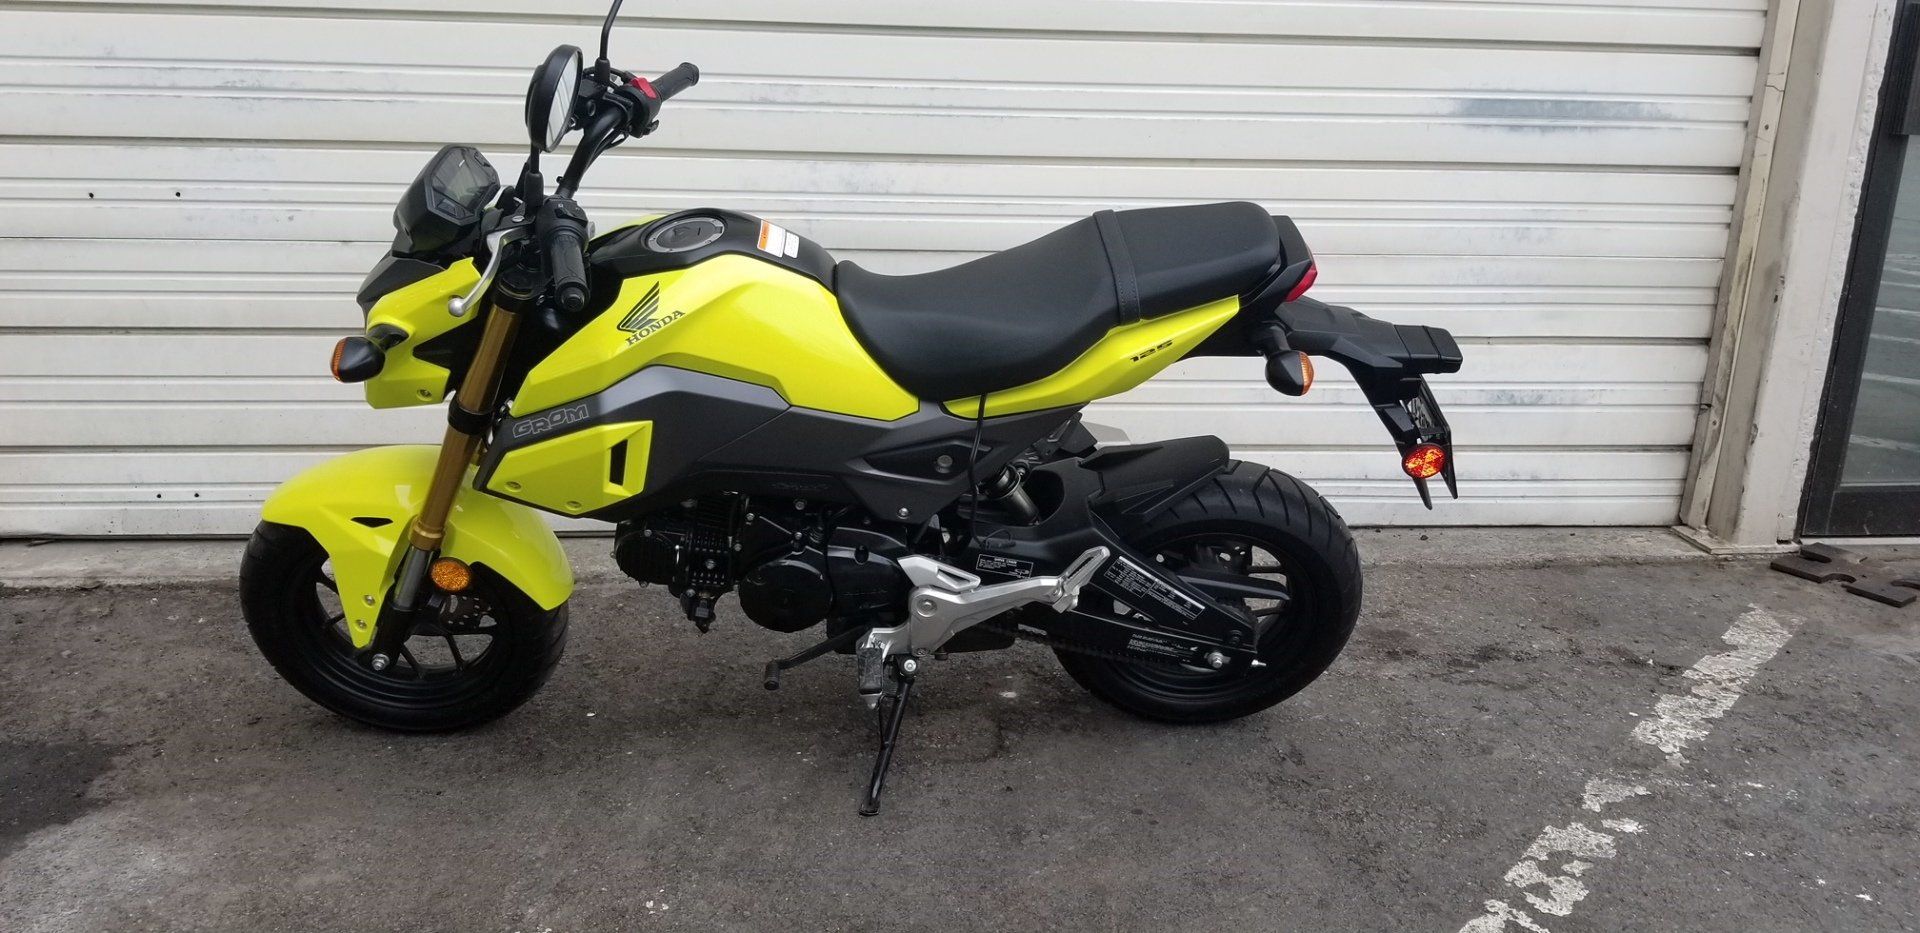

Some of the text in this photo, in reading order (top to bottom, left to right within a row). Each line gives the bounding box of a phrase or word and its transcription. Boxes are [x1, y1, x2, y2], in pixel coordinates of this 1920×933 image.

[625, 310, 685, 345] HONDA
[1130, 339, 1173, 362] 125
[512, 404, 590, 438] GROM
